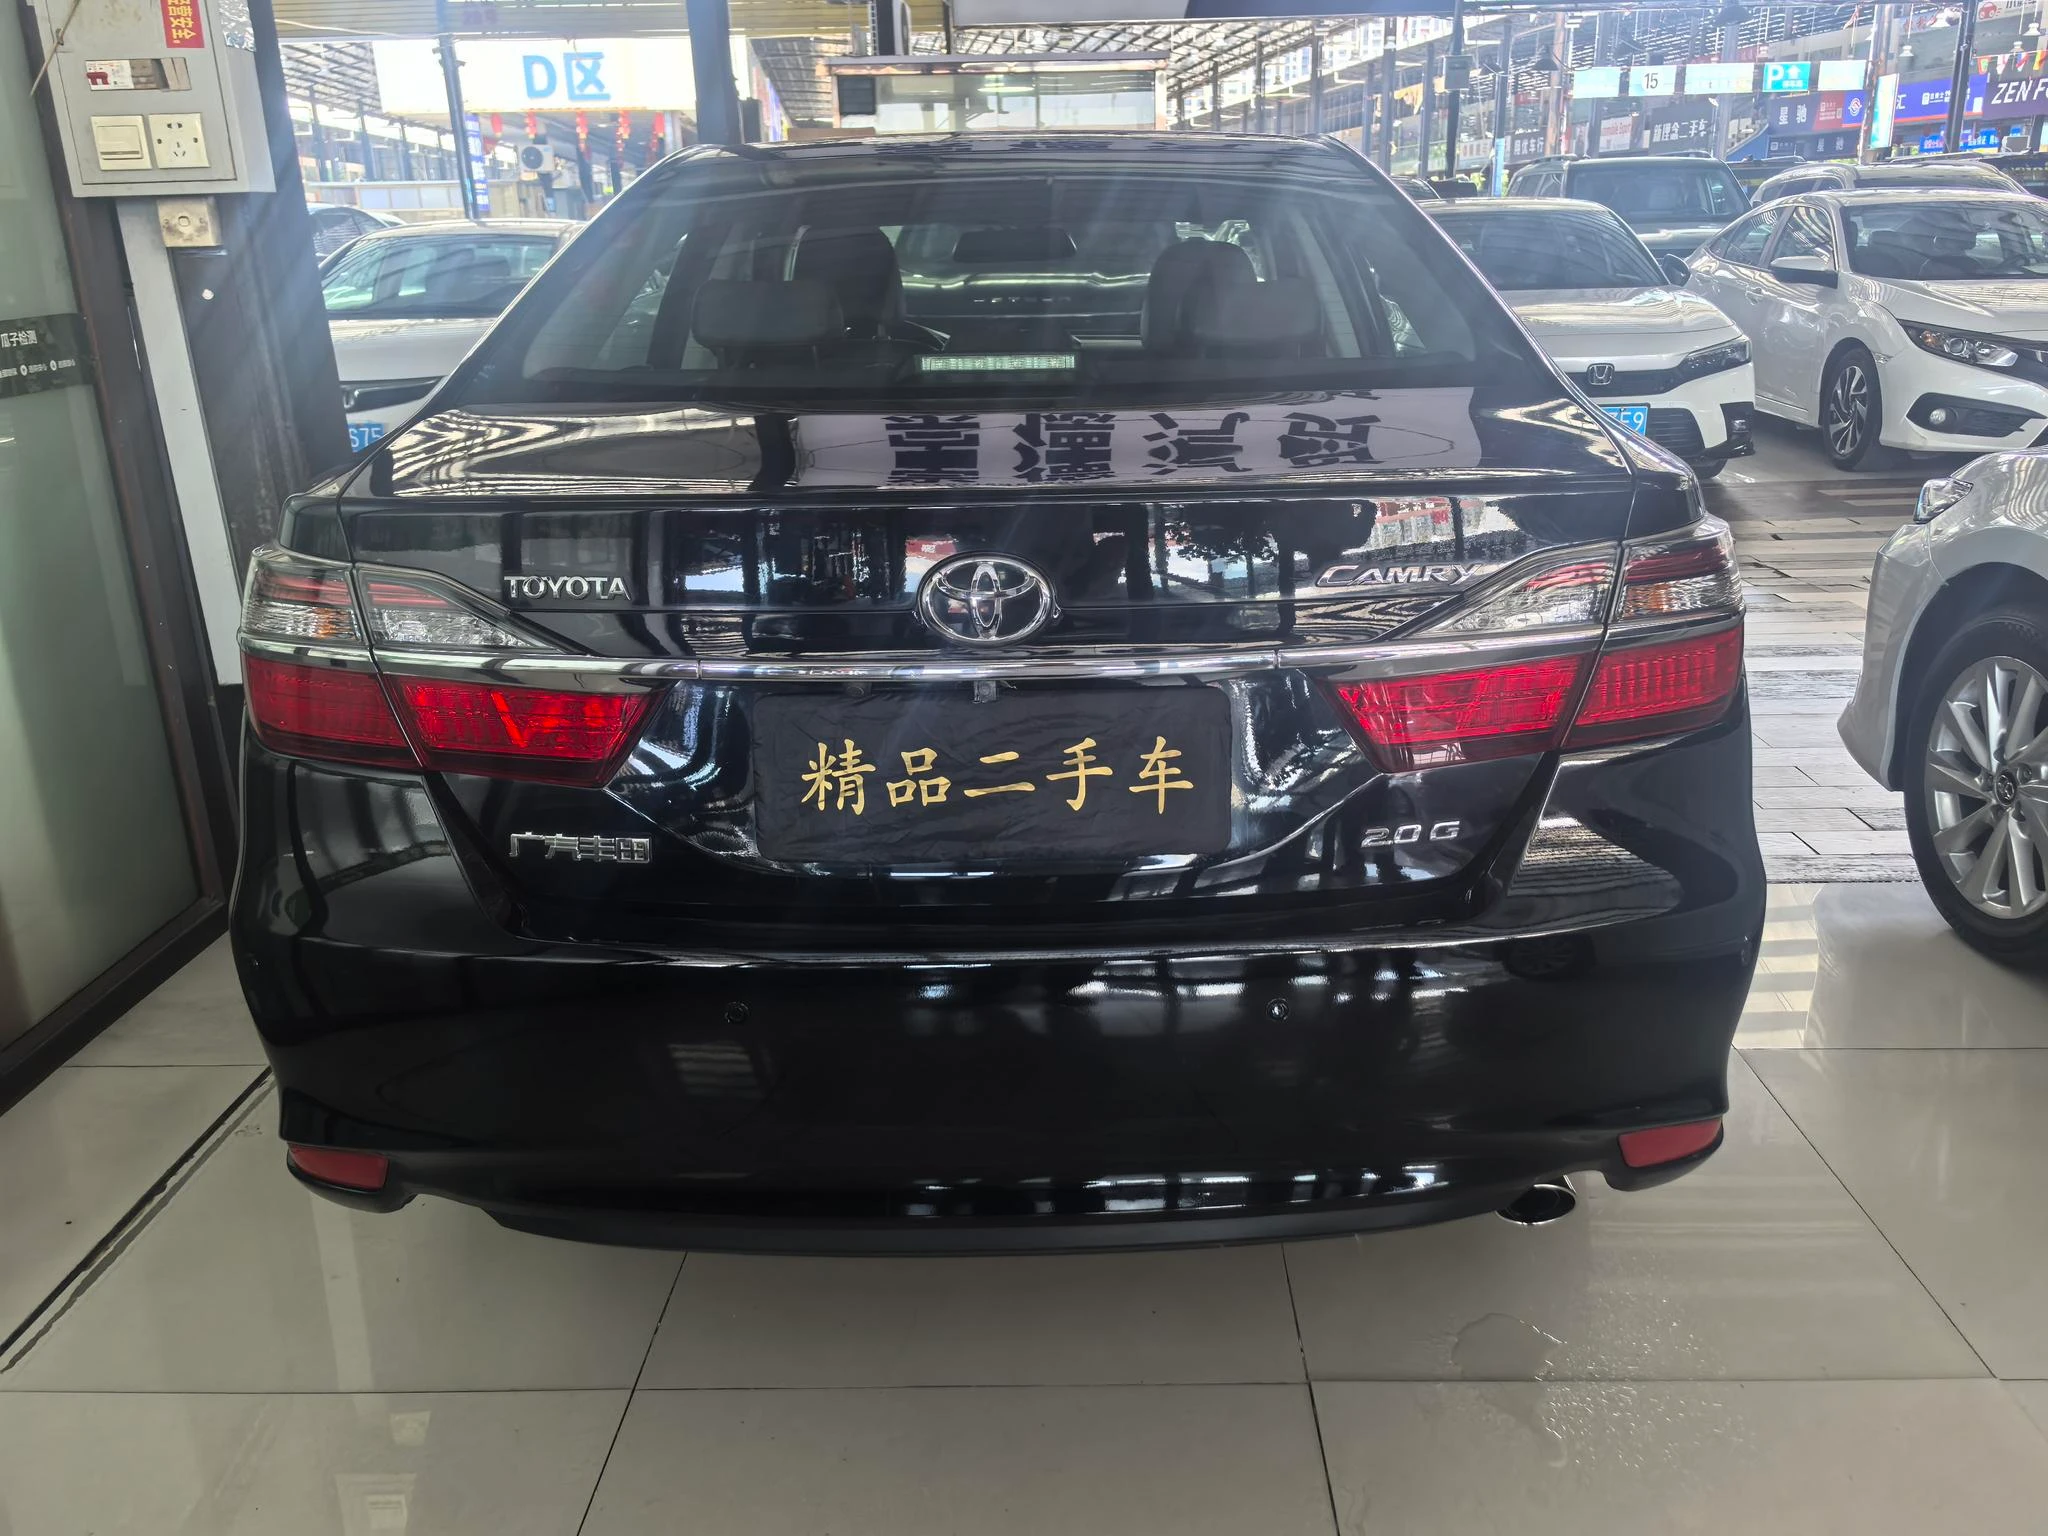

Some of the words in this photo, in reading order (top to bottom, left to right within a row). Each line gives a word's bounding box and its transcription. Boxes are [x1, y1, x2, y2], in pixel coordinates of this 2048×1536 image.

[523, 52, 611, 101] D区
[1644, 73, 1658, 89] 15
[1991, 80, 2033, 105] ZEN
[2033, 78, 2048, 100] F
[1653, 118, 1709, 142] 新理念二手车
[1316, 563, 1482, 587] CAMRY
[503, 576, 631, 601] TOYOTA
[801, 735, 1194, 816] 精品二手车
[509, 831, 651, 863] 广汽丰田
